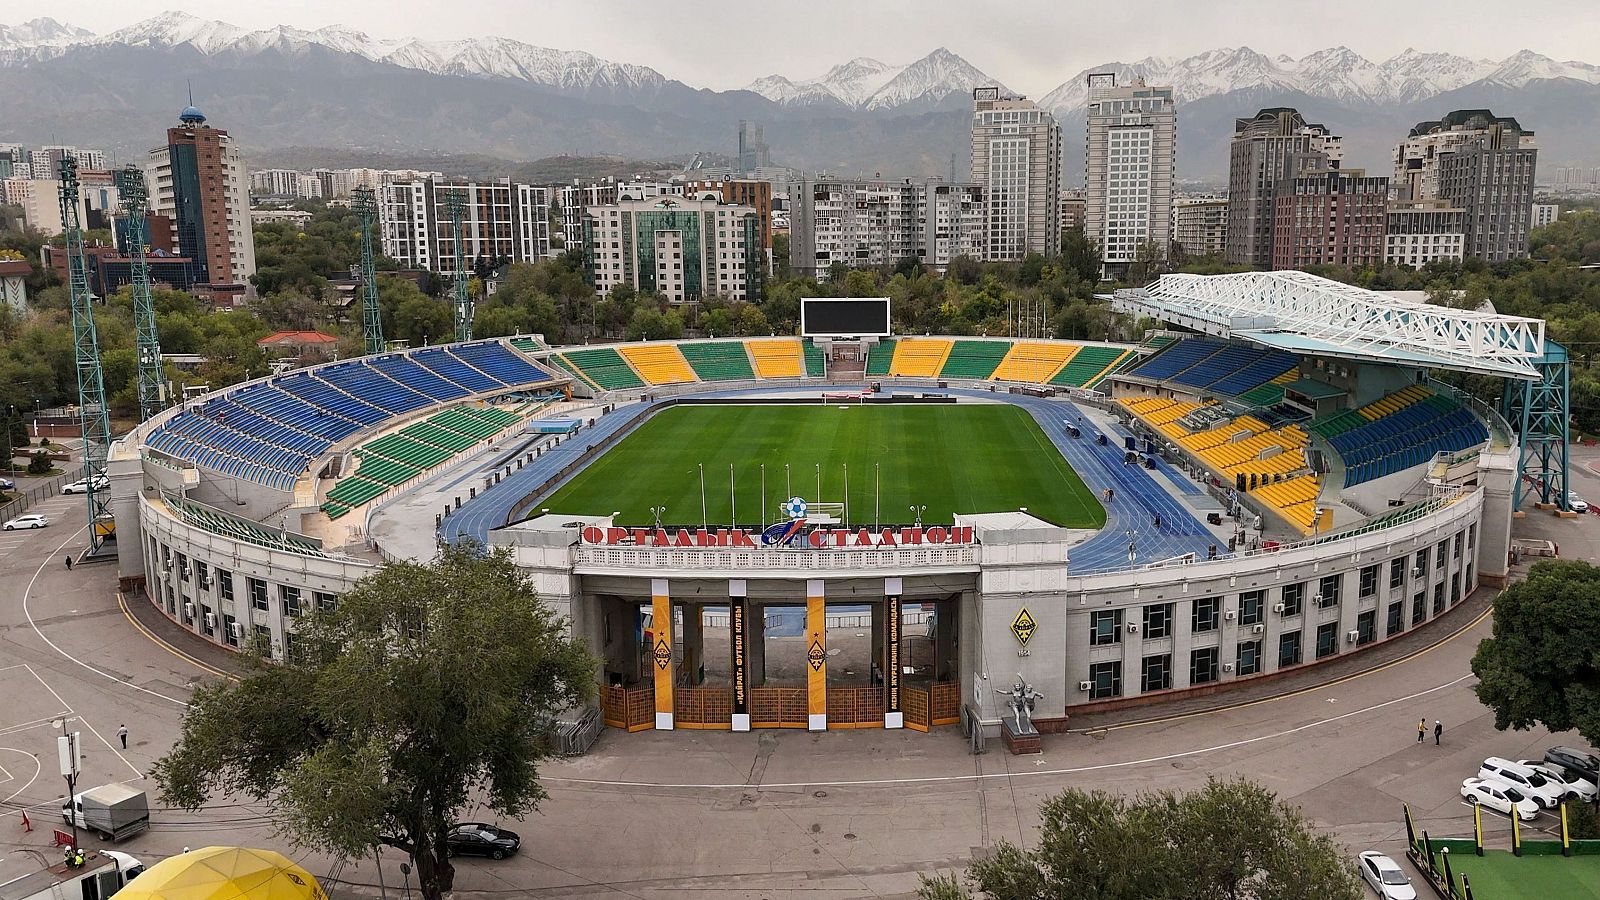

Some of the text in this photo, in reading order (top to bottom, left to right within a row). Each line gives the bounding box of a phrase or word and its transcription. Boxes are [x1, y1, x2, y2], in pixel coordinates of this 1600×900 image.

[583, 526, 973, 550] ОРТАЛЫҚ СТАДИОН
[735, 635, 743, 666] ФУТБОЛ
